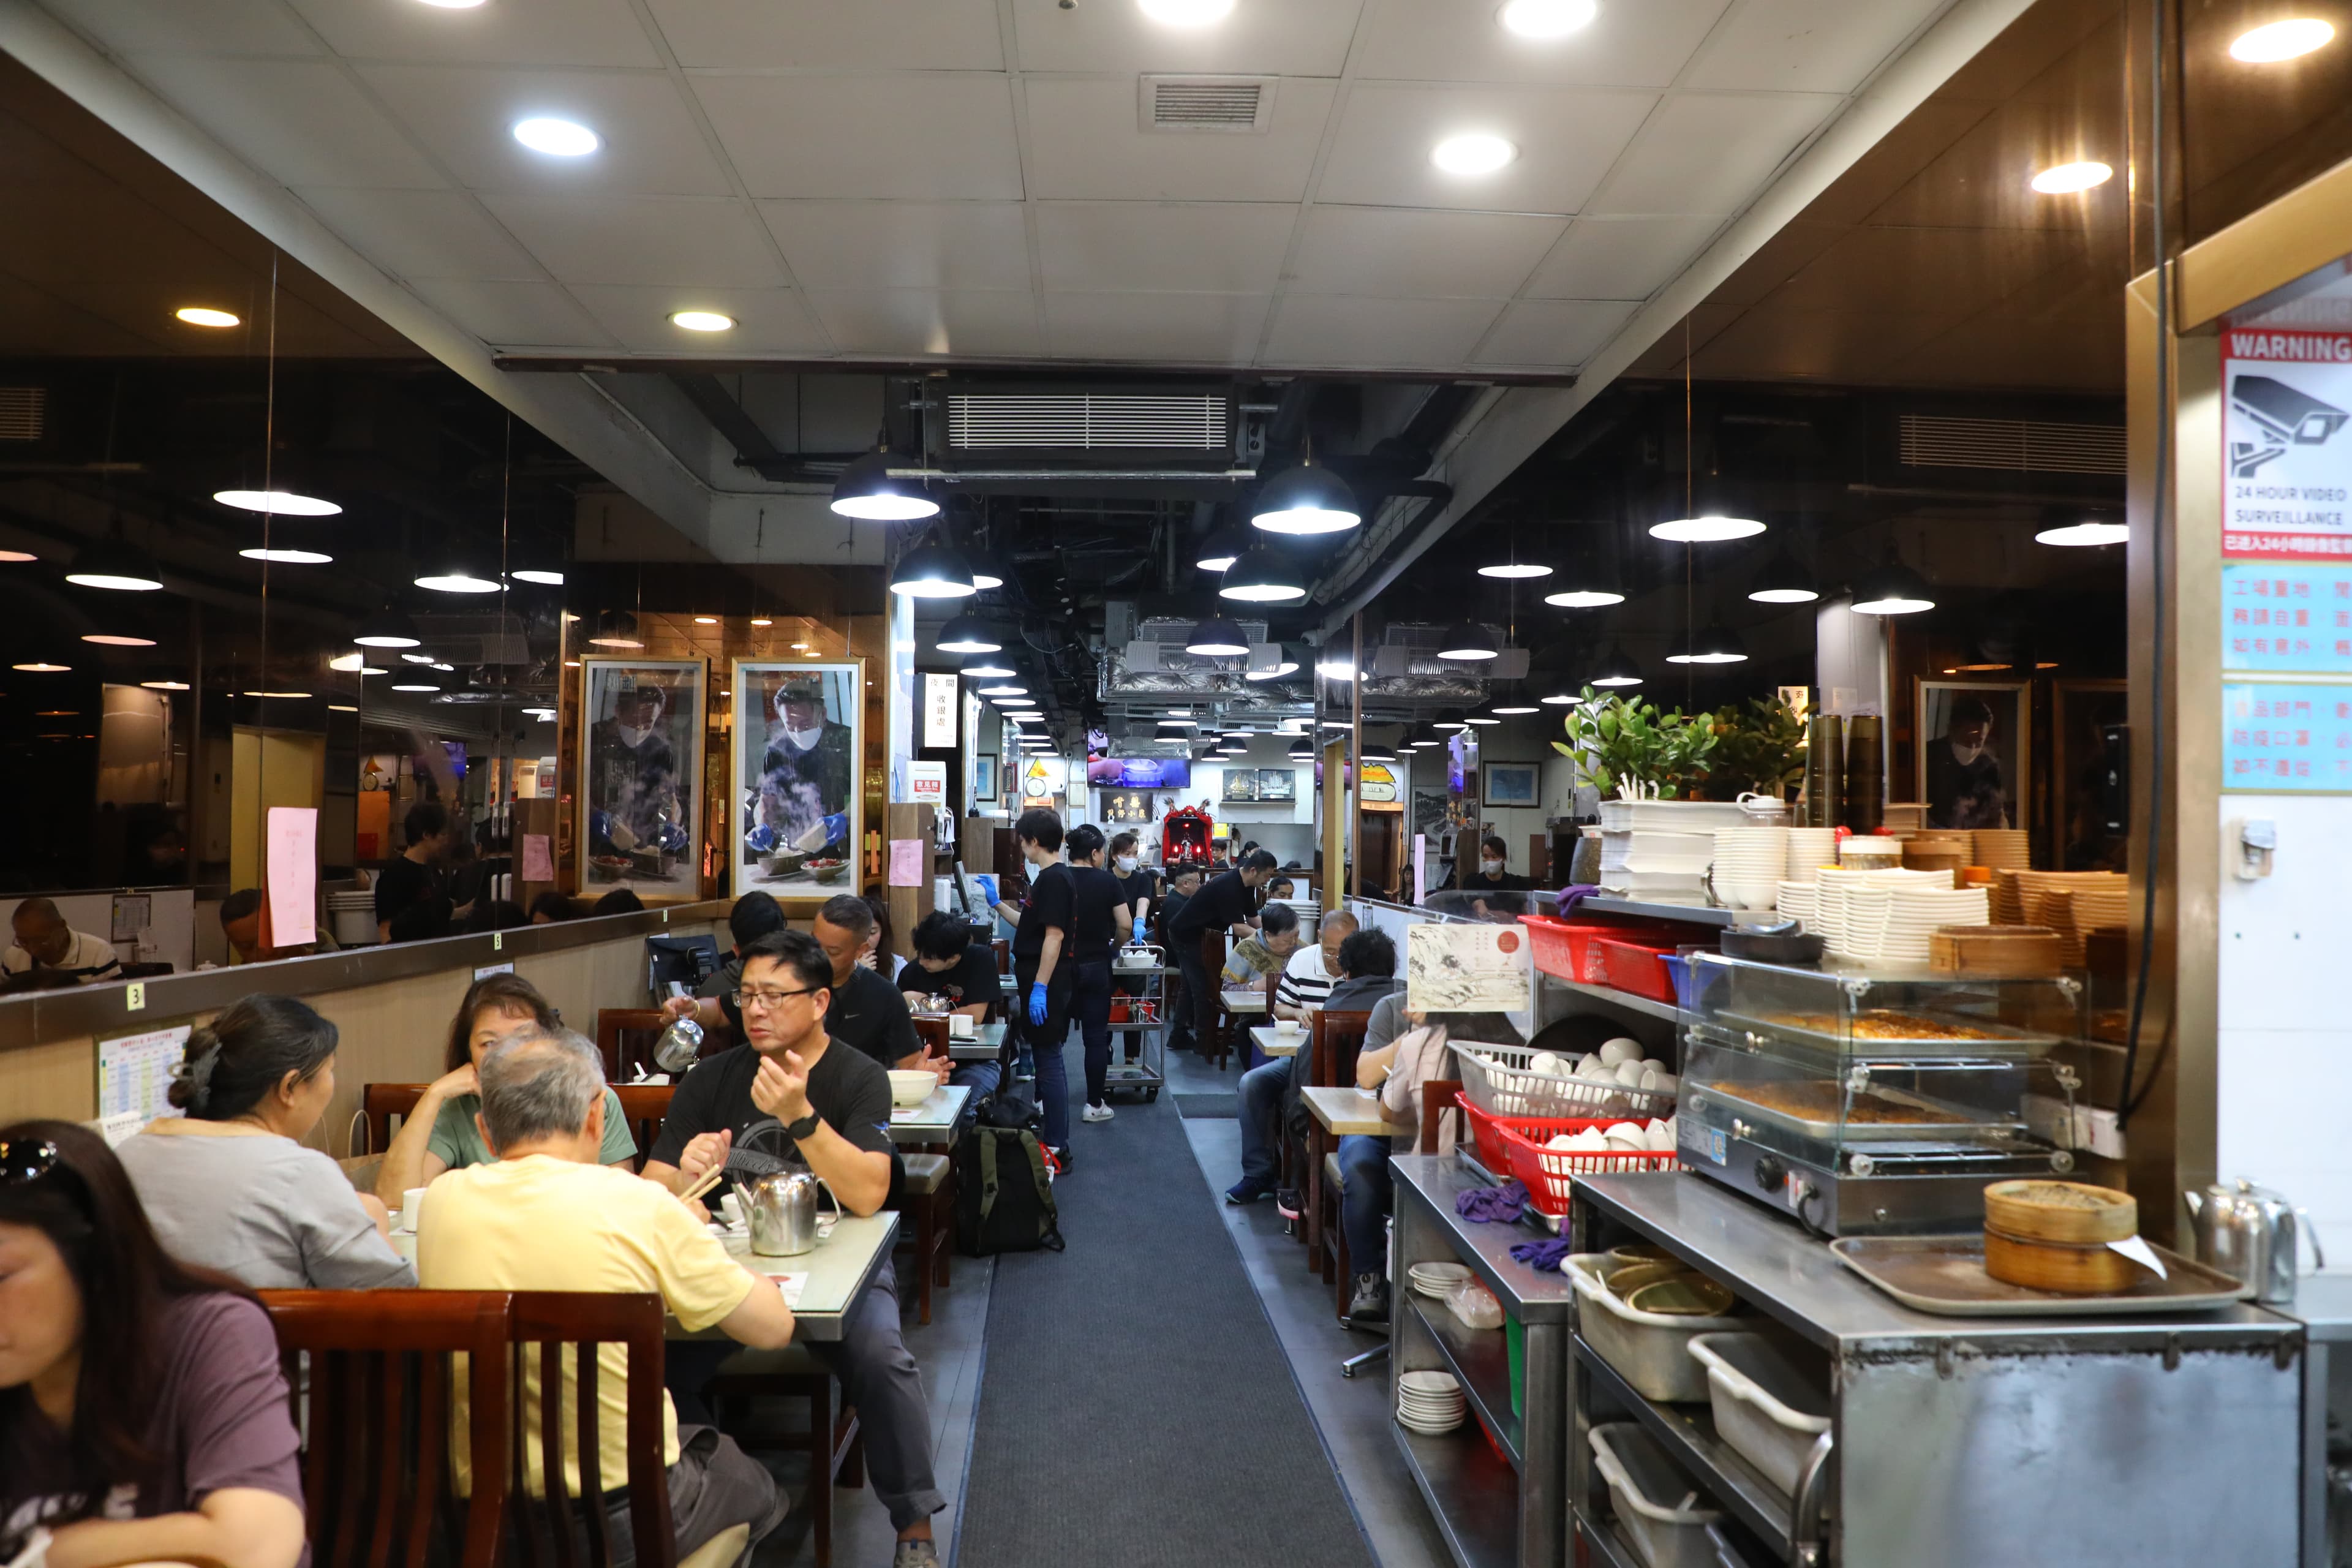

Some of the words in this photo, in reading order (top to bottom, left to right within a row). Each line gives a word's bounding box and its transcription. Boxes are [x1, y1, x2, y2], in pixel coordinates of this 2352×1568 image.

[2231, 333, 2351, 360] WARNING
[2236, 486, 2252, 499] 24
[2256, 487, 2297, 500] HOUR
[2304, 489, 2346, 502] VIDEO
[2236, 510, 2342, 526] SURVEILLANCE
[497, 936, 500, 946] 5
[132, 989, 140, 1005] 3
